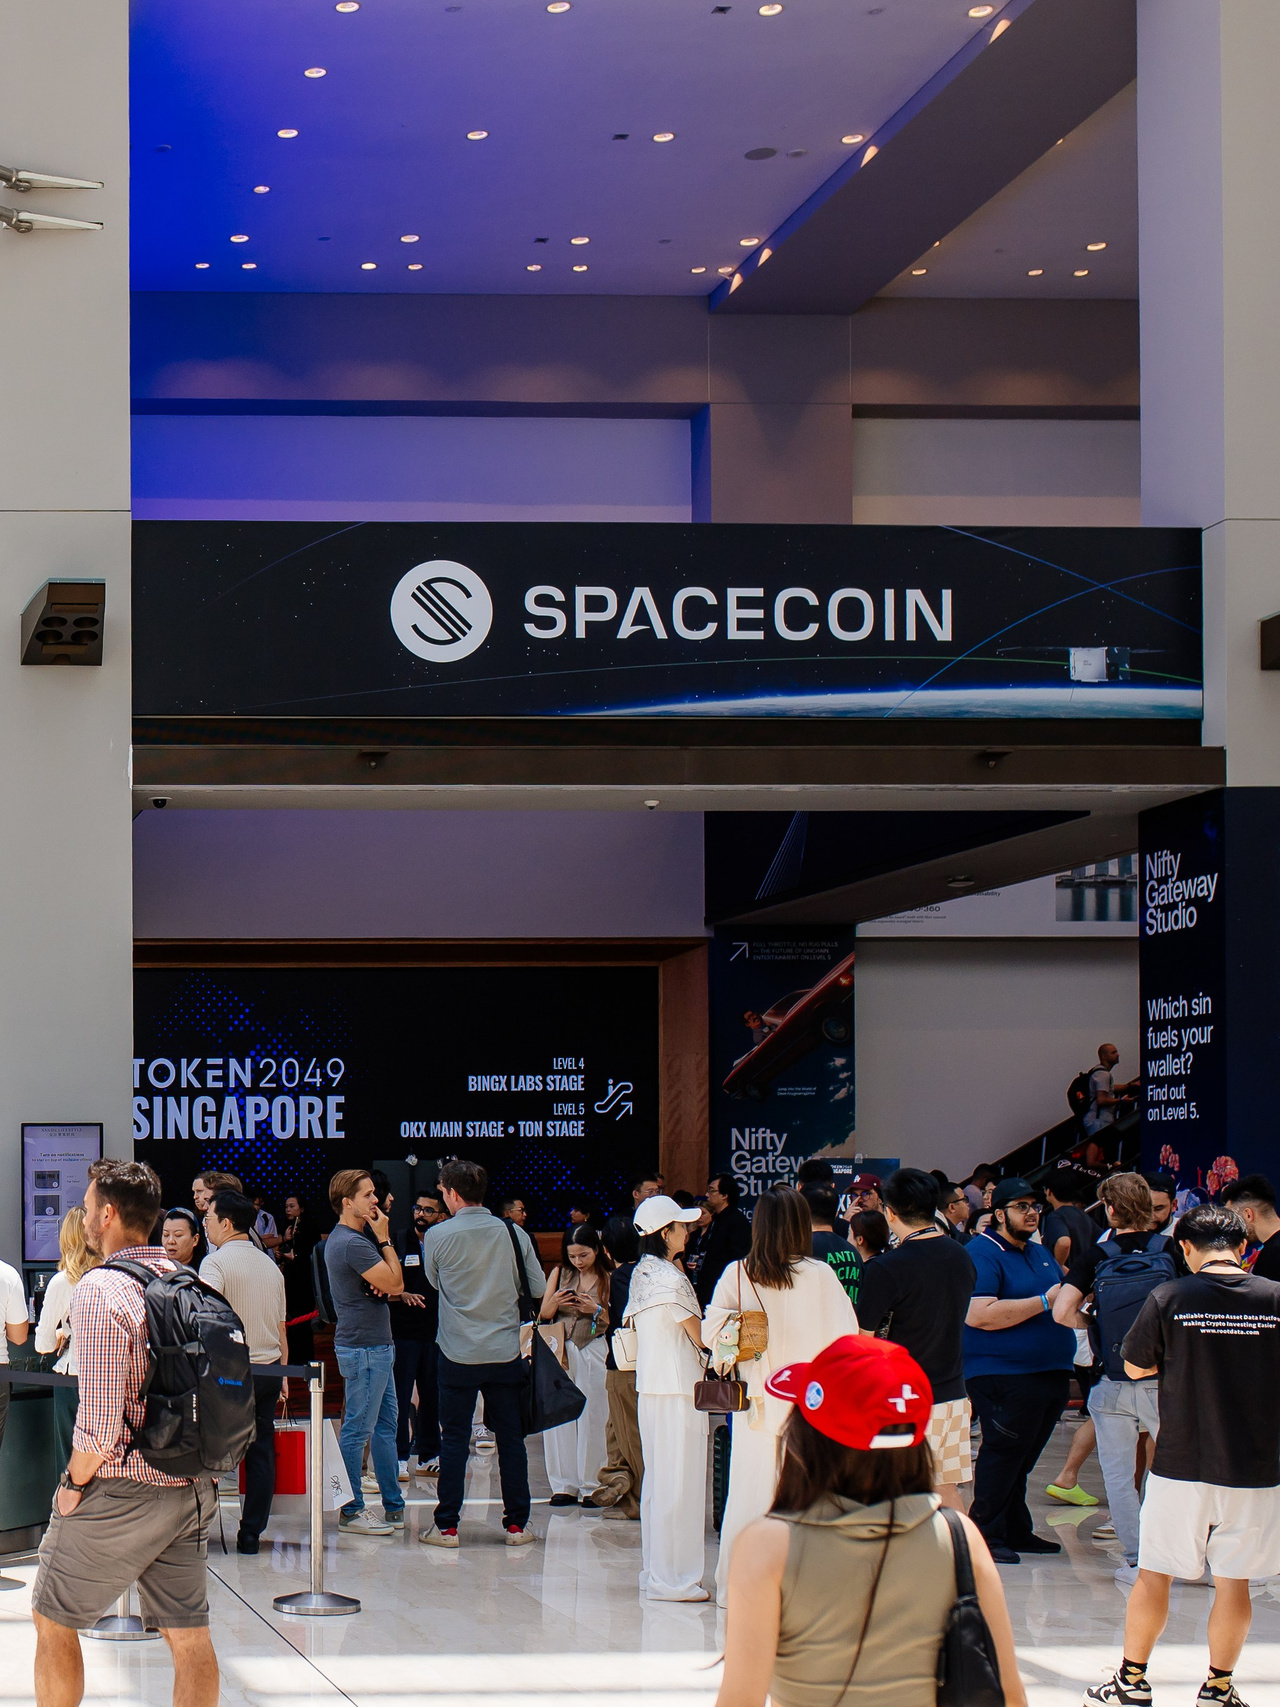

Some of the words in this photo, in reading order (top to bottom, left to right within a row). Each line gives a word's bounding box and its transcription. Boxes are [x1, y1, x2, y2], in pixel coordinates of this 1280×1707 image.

[524, 585, 953, 642] SPACECOIN
[1145, 849, 1181, 882] Nifty
[1145, 873, 1219, 908] Gateway
[1145, 902, 1198, 936] Studio
[1147, 995, 1188, 1022] Which
[1191, 992, 1212, 1016] sin
[1147, 1026, 1179, 1049] fuels
[1181, 1025, 1214, 1051] your
[133, 1058, 345, 1089] TOKEN2049
[553, 1057, 577, 1070] LEVEL
[578, 1057, 585, 1070] 4
[1147, 1052, 1193, 1078] wallet?
[468, 1075, 508, 1091] BINGX
[511, 1075, 543, 1091] LABS
[546, 1075, 585, 1091] STAGE
[1147, 1084, 1168, 1102] Find
[1169, 1085, 1186, 1100] out
[133, 1096, 345, 1140] SINGAPORE
[553, 1103, 577, 1115] LEVEL
[578, 1103, 585, 1115] 5
[1147, 1108, 1160, 1122] on
[1161, 1103, 1188, 1121] Level
[1189, 1102, 1200, 1120] 5.
[400, 1121, 427, 1138] OKX
[429, 1121, 463, 1138] MAIN
[465, 1121, 505, 1138] STAGE
[518, 1121, 543, 1137] TON
[546, 1121, 585, 1137] STAGE
[731, 1127, 788, 1156] Nifty
[826, 1250, 856, 1265] ANTI
[1179, 1312, 1204, 1320] Reliable
[1204, 1312, 1225, 1320] Crypto
[1226, 1321, 1257, 1329] Investing
[1200, 1328, 1260, 1336] www.rootdata.com
